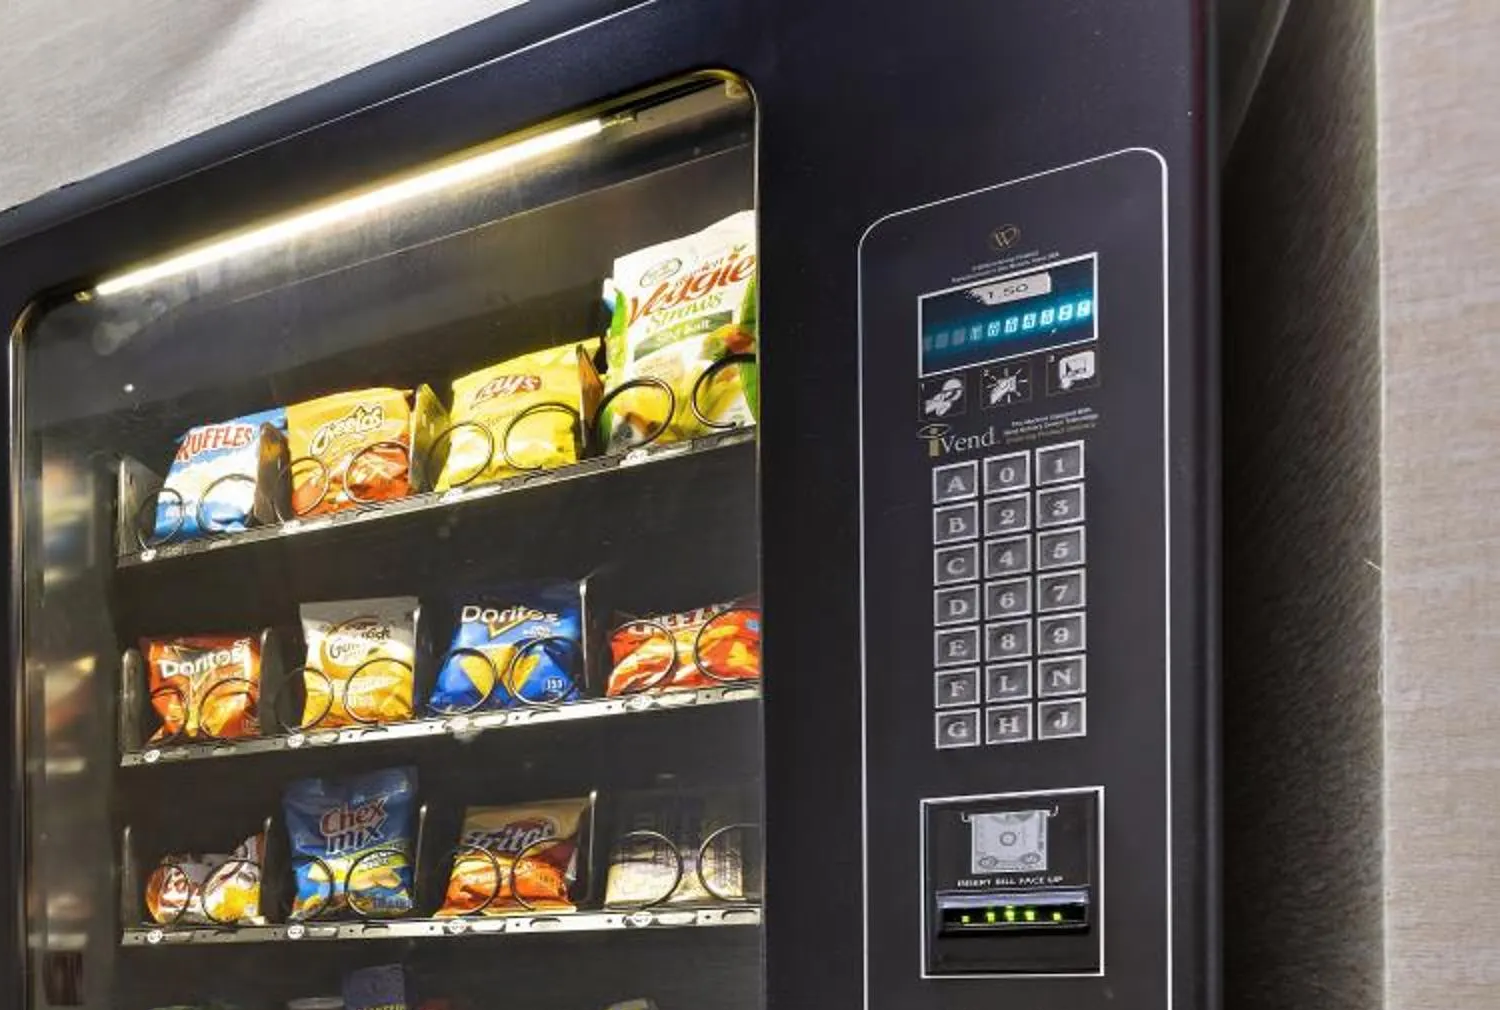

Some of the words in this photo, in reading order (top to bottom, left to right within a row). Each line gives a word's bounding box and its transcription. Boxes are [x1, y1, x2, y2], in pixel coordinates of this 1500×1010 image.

[175, 424, 253, 462] RUFFLES
[947, 475, 966, 492] A
[1053, 457, 1065, 474] 1
[948, 517, 967, 533] B
[1000, 509, 1016, 525] 2
[1052, 500, 1069, 516] 3
[946, 557, 965, 574] C
[999, 551, 1014, 567] 4
[1052, 542, 1069, 559] 5
[460, 604, 559, 624] Doritos
[948, 599, 968, 616] D
[999, 592, 1015, 609] 6
[1052, 585, 1068, 601] 7
[948, 639, 967, 656] E
[1001, 633, 1016, 650] 8
[1052, 627, 1069, 643] 9
[161, 644, 247, 679] Doritos
[949, 679, 967, 697] F
[999, 675, 1018, 692] L
[1051, 667, 1072, 687] N
[947, 720, 967, 737] G
[998, 716, 1020, 734] H
[1053, 711, 1069, 728] J
[320, 796, 388, 837] Chex
[995, 877, 1016, 886] BILL
